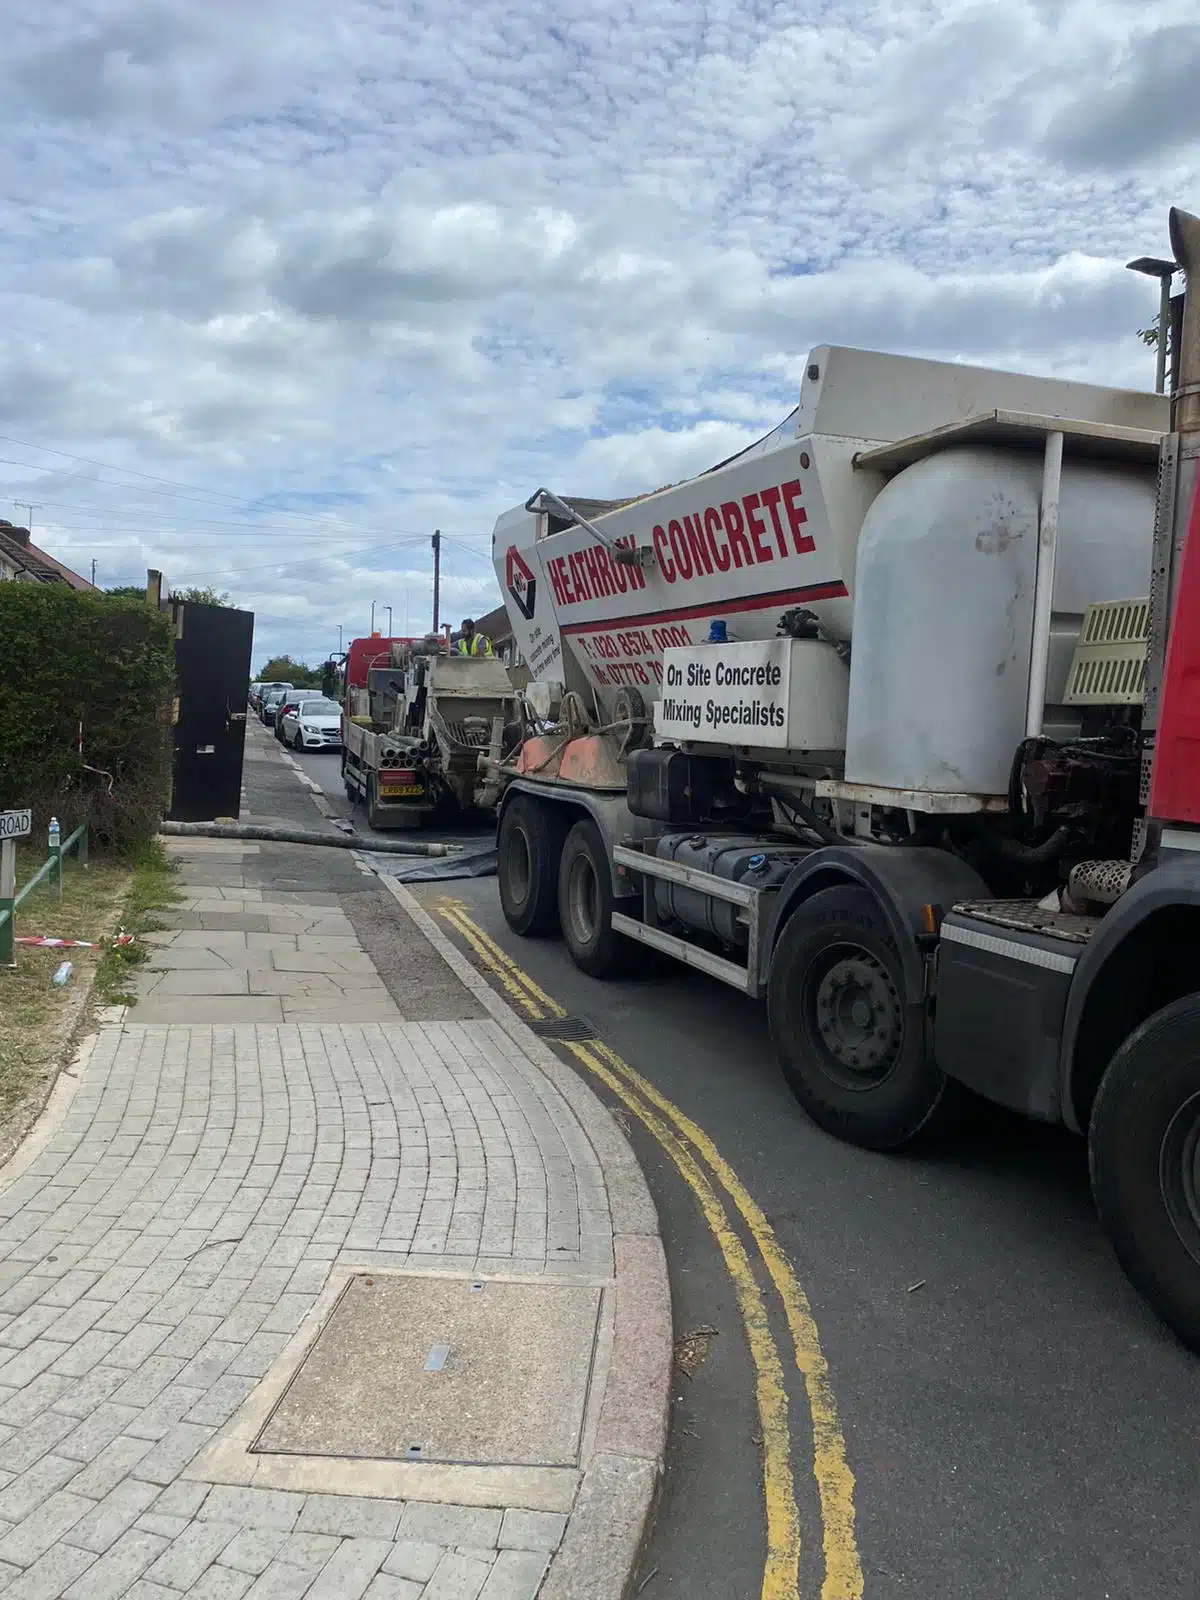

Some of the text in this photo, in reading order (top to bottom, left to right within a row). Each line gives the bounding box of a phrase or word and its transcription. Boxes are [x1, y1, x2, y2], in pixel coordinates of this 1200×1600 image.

[547, 479, 816, 606] HEATHROW CONCRETE
[577, 637, 598, 659] T:
[593, 634, 620, 659] 020
[617, 629, 655, 657] 8574
[667, 660, 781, 687] On Site Concrete
[663, 699, 785, 729] Mixing Specialists
[0, 815, 29, 836] ROAD
